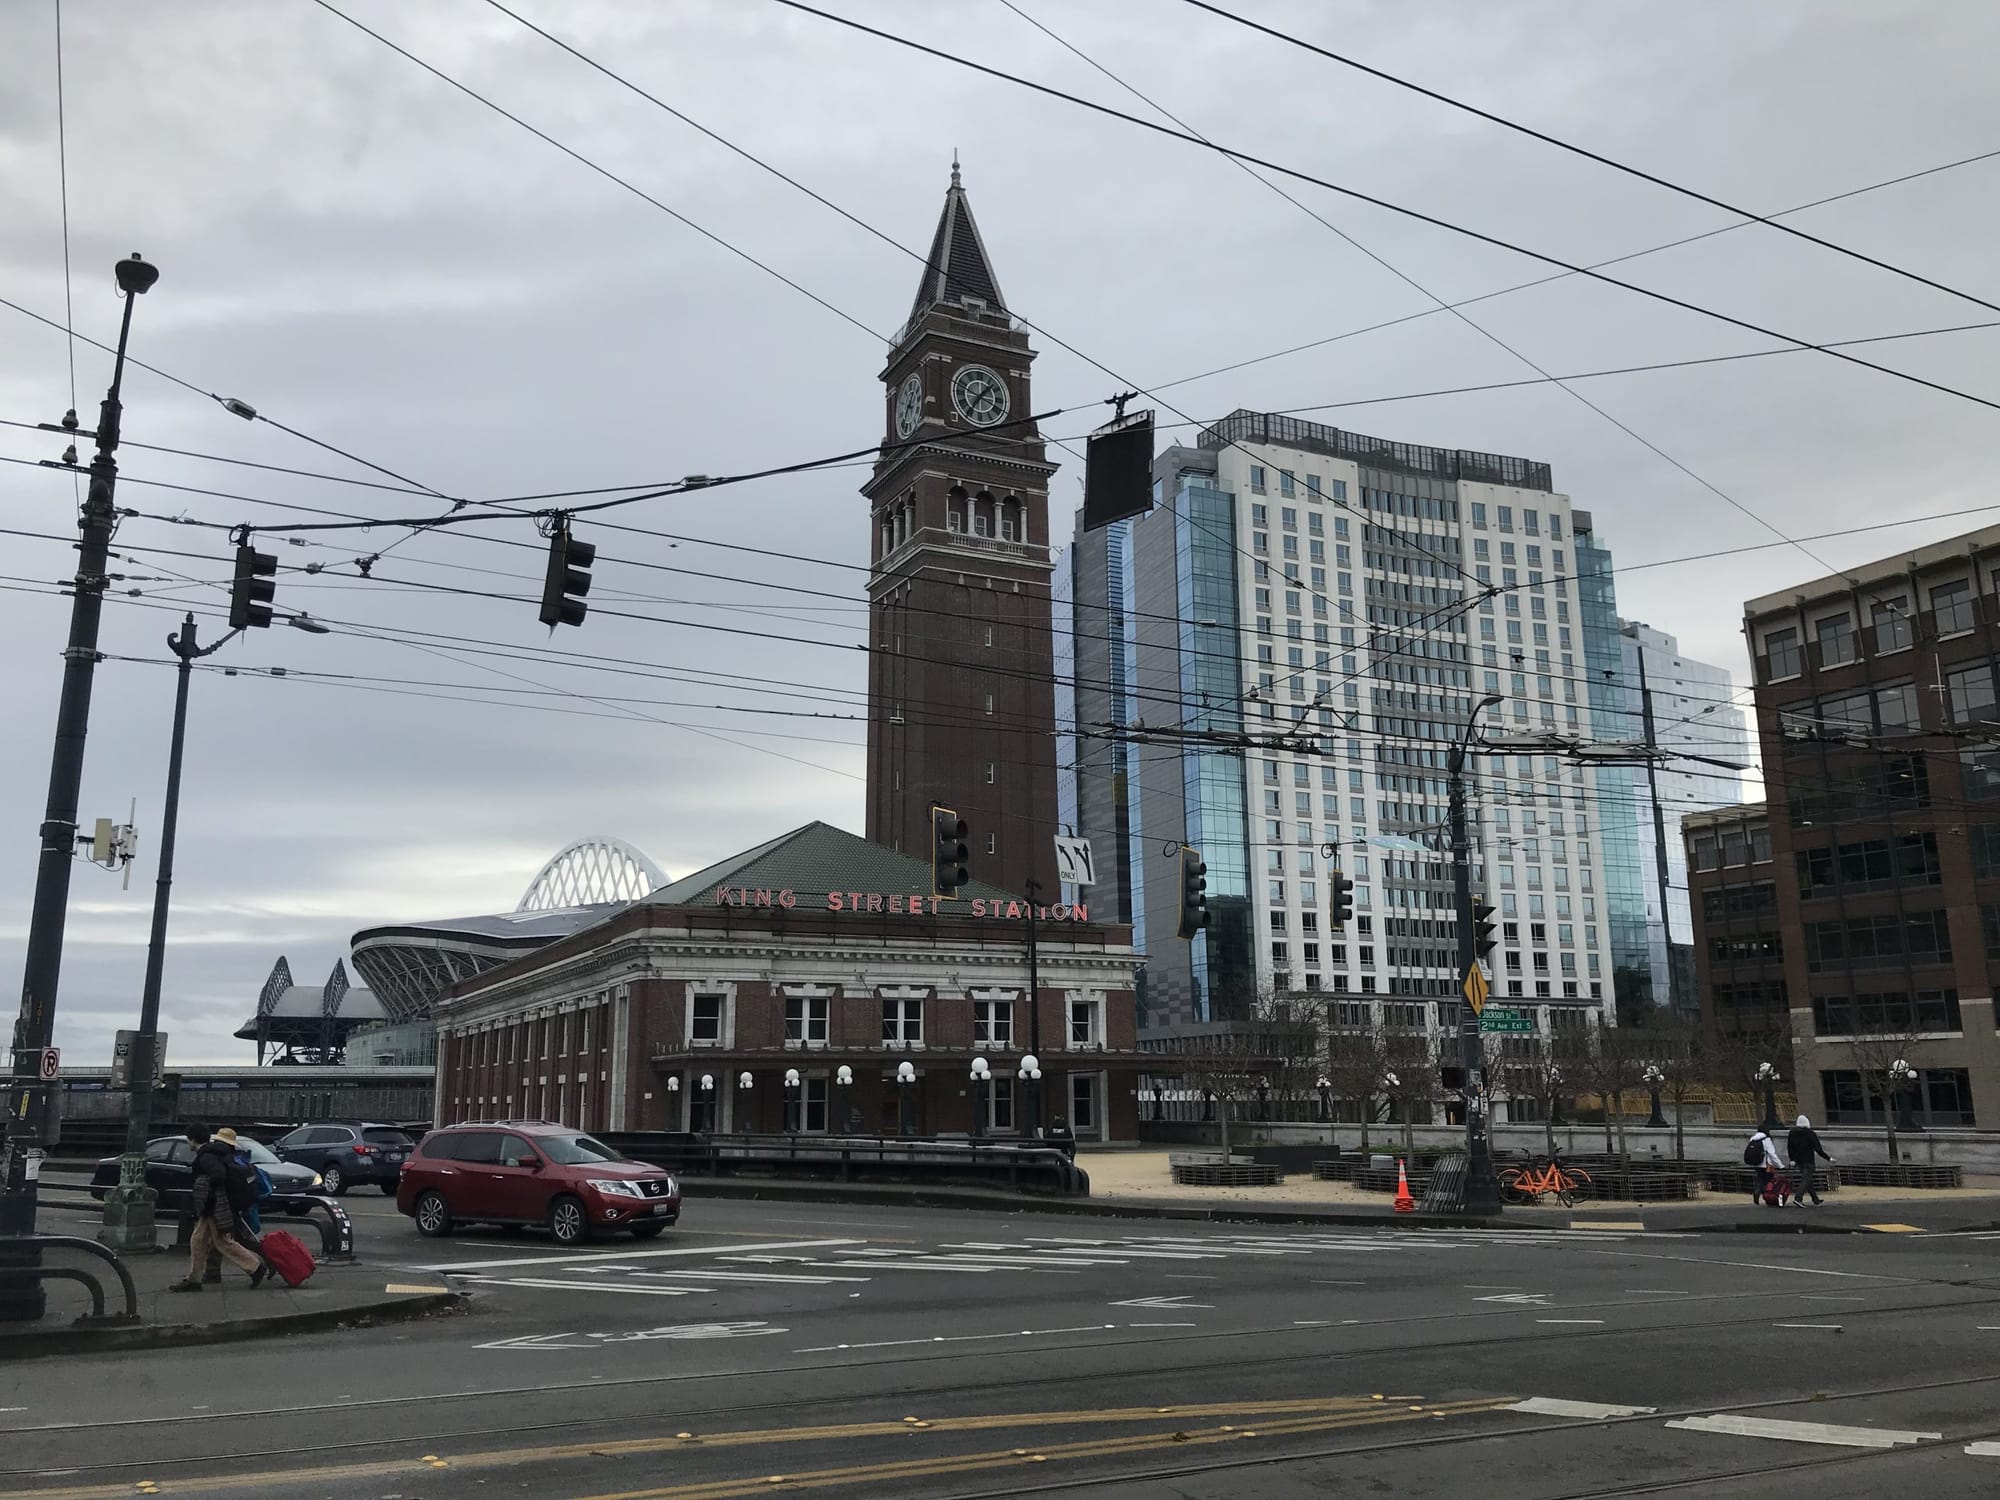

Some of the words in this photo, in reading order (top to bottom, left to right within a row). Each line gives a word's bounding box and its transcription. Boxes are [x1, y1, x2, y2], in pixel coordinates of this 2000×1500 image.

[1061, 871, 1076, 880] ONLY
[716, 886, 796, 908] KING
[828, 891, 942, 915] STREET
[971, 898, 1088, 922] STATION
[1482, 1009, 1505, 1019] Jackson
[1481, 1021, 1496, 1031] 2nd
[1497, 1022, 1508, 1030] Ave
[1511, 1022, 1522, 1030] Ext
[1526, 1022, 1531, 1030] S
